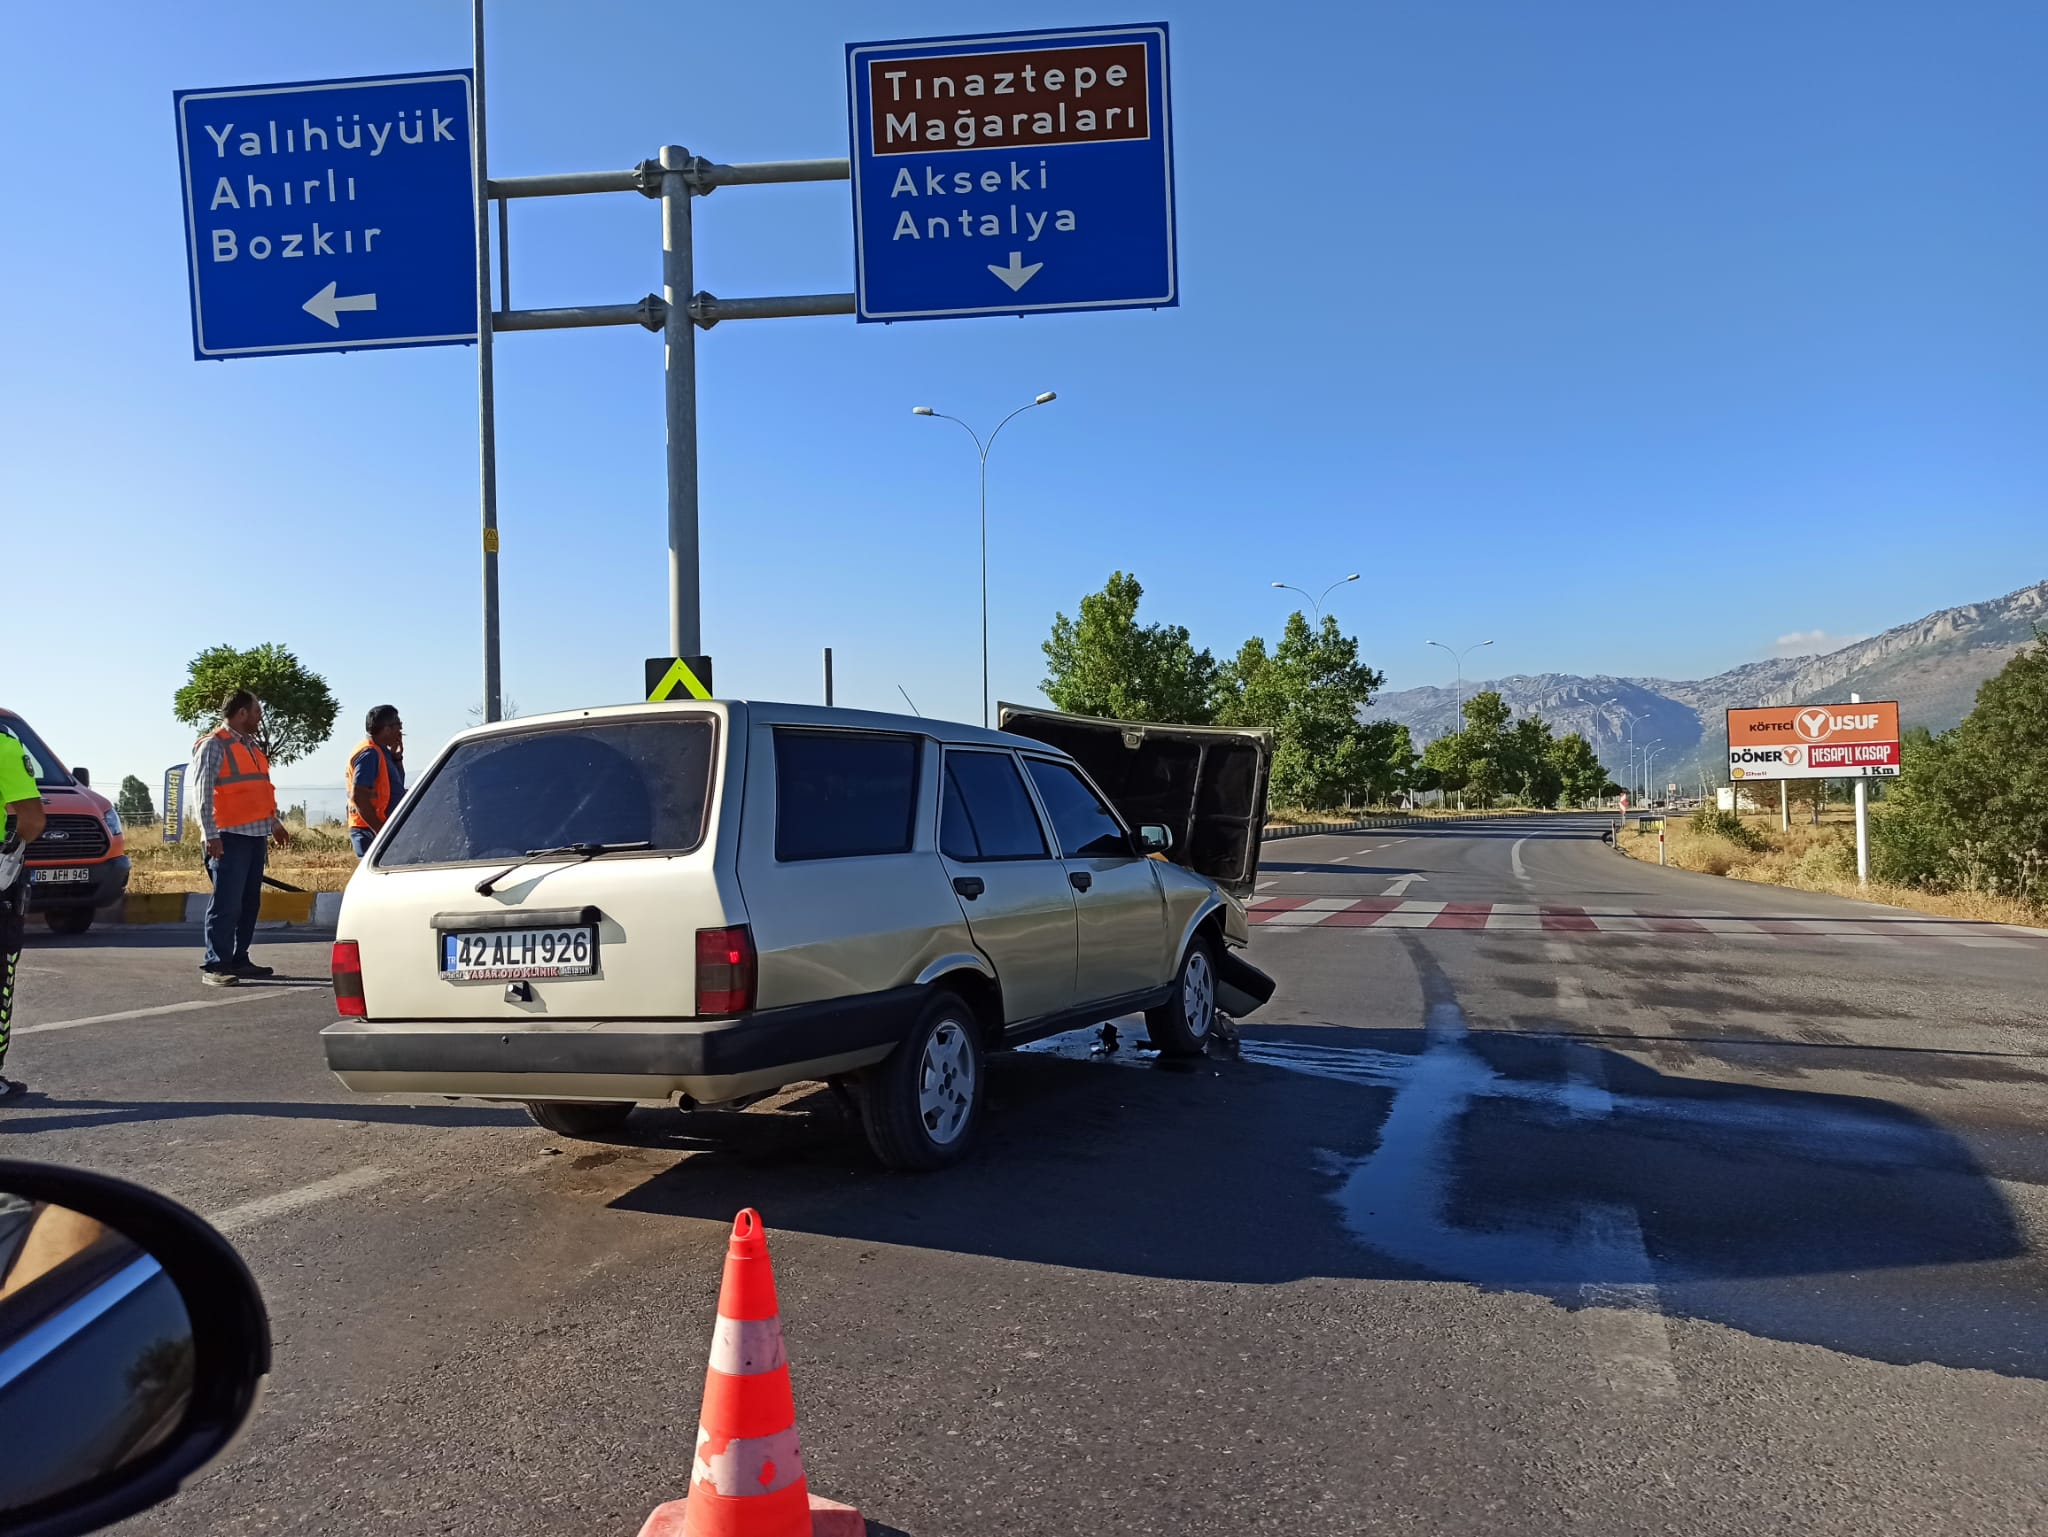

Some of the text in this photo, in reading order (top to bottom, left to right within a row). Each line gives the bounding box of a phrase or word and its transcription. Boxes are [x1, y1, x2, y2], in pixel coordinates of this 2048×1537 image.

[884, 64, 1128, 101] Tınaztepe
[204, 108, 456, 158] Yalıhüyük
[885, 102, 1135, 146] Mağaraları
[210, 168, 356, 211] Ahırlı
[891, 160, 1048, 198] Akseki
[893, 204, 1076, 241] Antalya
[211, 222, 382, 262] Bozkır
[1749, 713, 1879, 737] KÖFTECİ YUSUF
[1731, 748, 1783, 763] DÖNER
[1811, 745, 1891, 766] HESAPLI KASAP
[1861, 766, 1894, 775] 1 Km
[36, 870, 47, 881] 06
[458, 931, 588, 967] 42 ALH 926
